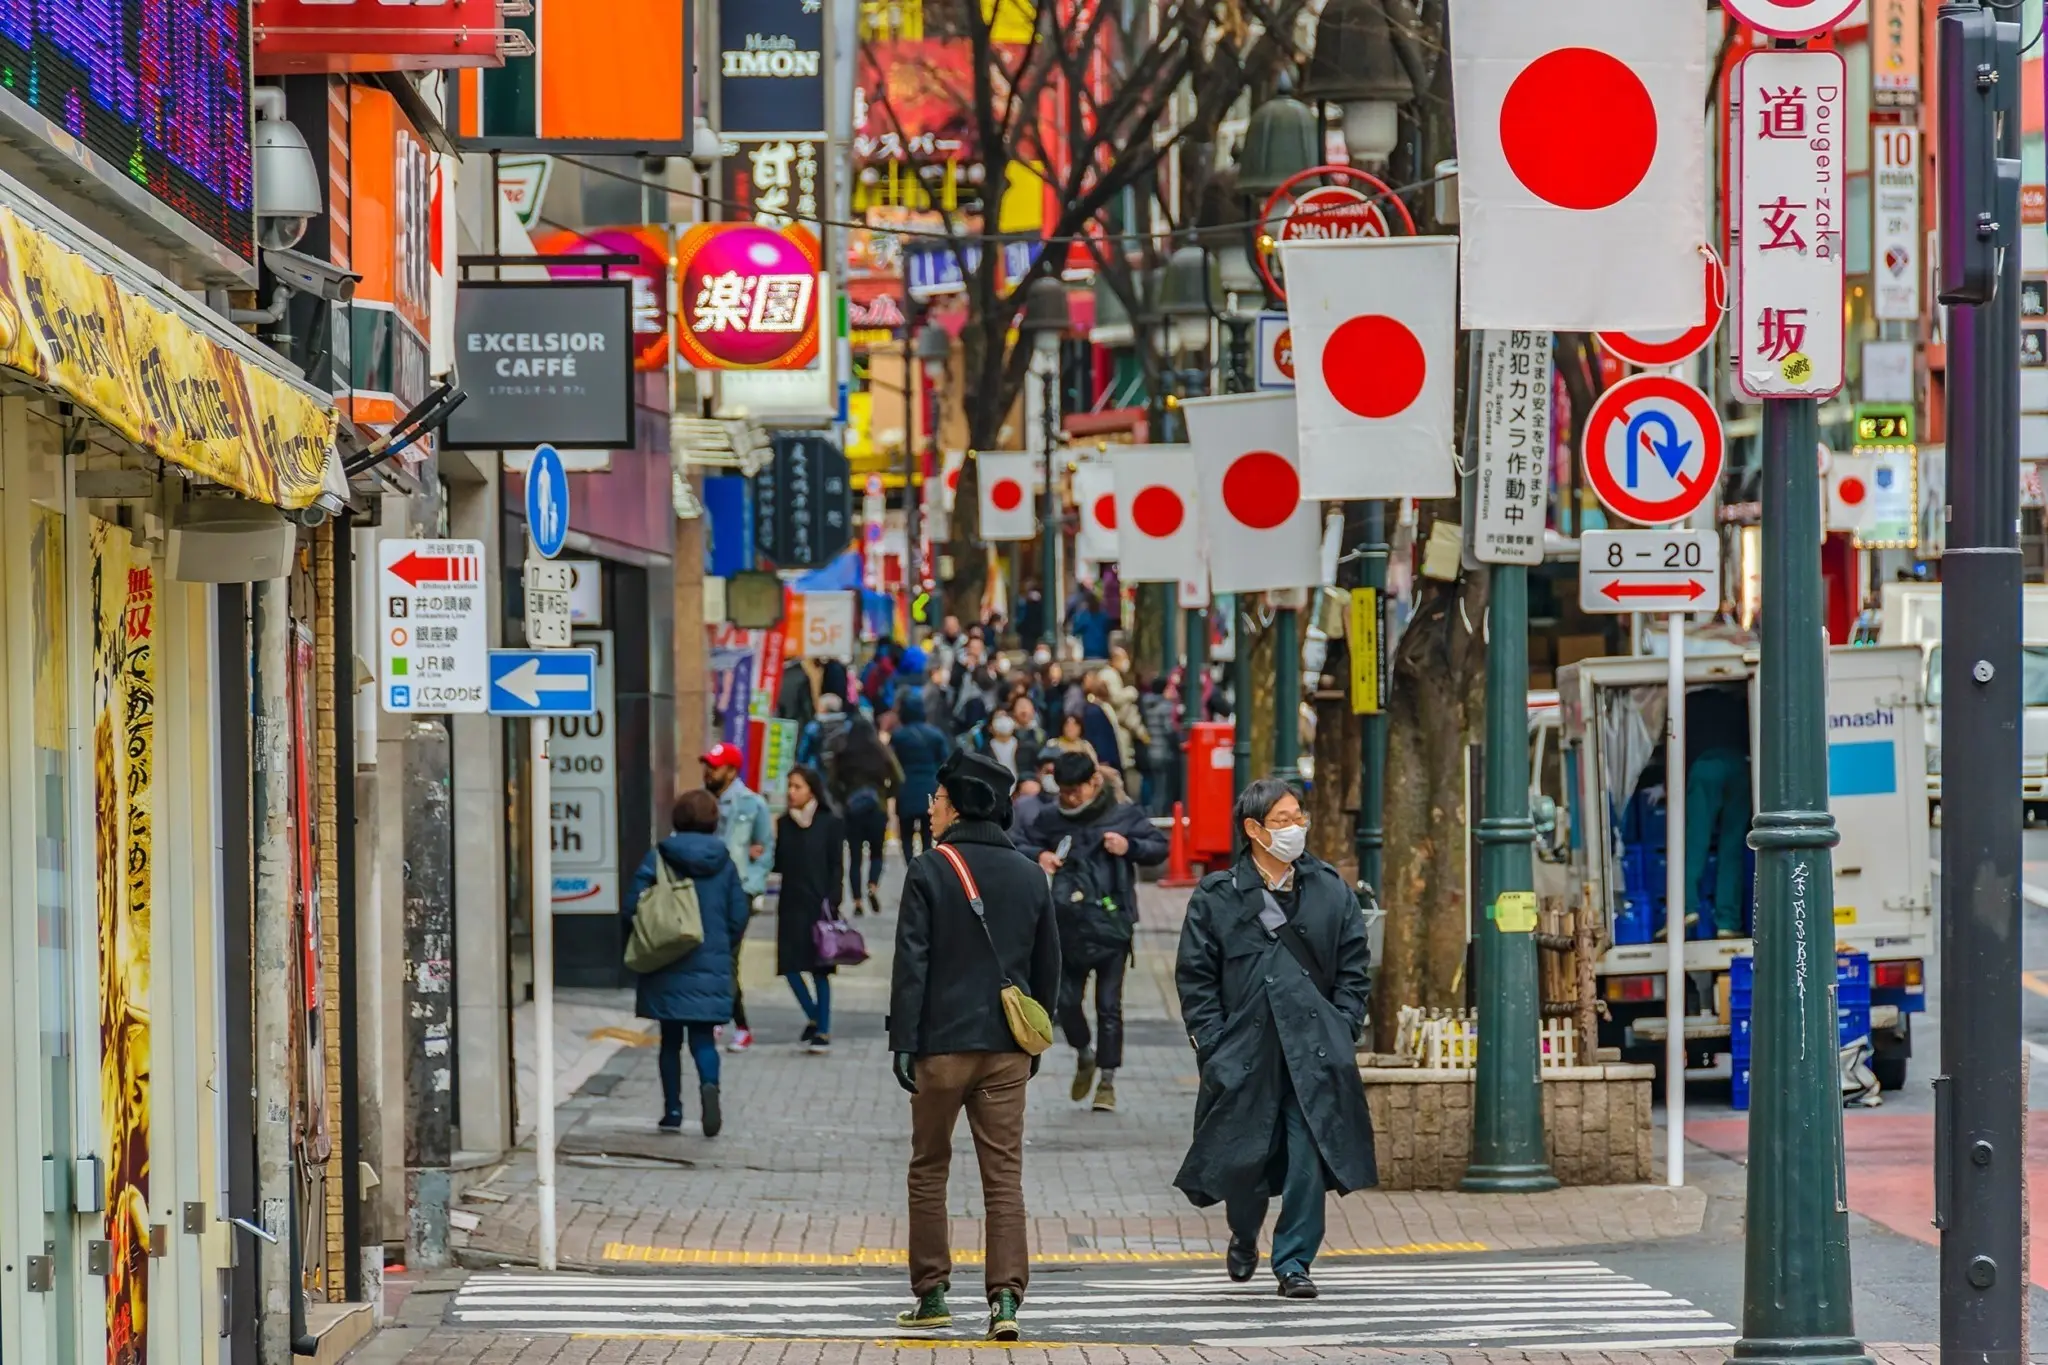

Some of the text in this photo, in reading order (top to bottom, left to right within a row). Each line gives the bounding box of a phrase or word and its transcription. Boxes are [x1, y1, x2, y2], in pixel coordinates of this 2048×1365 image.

[722, 51, 820, 78] IMON
[1882, 131, 1912, 167] 10
[1811, 86, 1838, 259] Dougen-zaka
[1757, 85, 1808, 362] 道玄坂
[692, 270, 814, 333] 楽園
[467, 333, 605, 352] EXCELSIOR
[1497, 340, 1506, 358] For
[495, 353, 577, 377] CAFFÉ
[1485, 352, 1496, 394] Security
[1485, 401, 1494, 446] Cameras
[1494, 394, 1504, 426] Safety
[1530, 330, 1548, 508] なさまの安全を守ります
[1505, 330, 1532, 527] 防犯カメラ作動中
[1482, 469, 1493, 520] Operation
[426, 543, 475, 554] 渋谷駅方面
[1495, 546, 1525, 556] Police
[415, 596, 472, 611] 井の頭線
[415, 626, 458, 641] 銀座線
[416, 686, 482, 701] バスのりば
[1829, 706, 1894, 730] anashi
[127, 567, 152, 910] 無双であるがために
